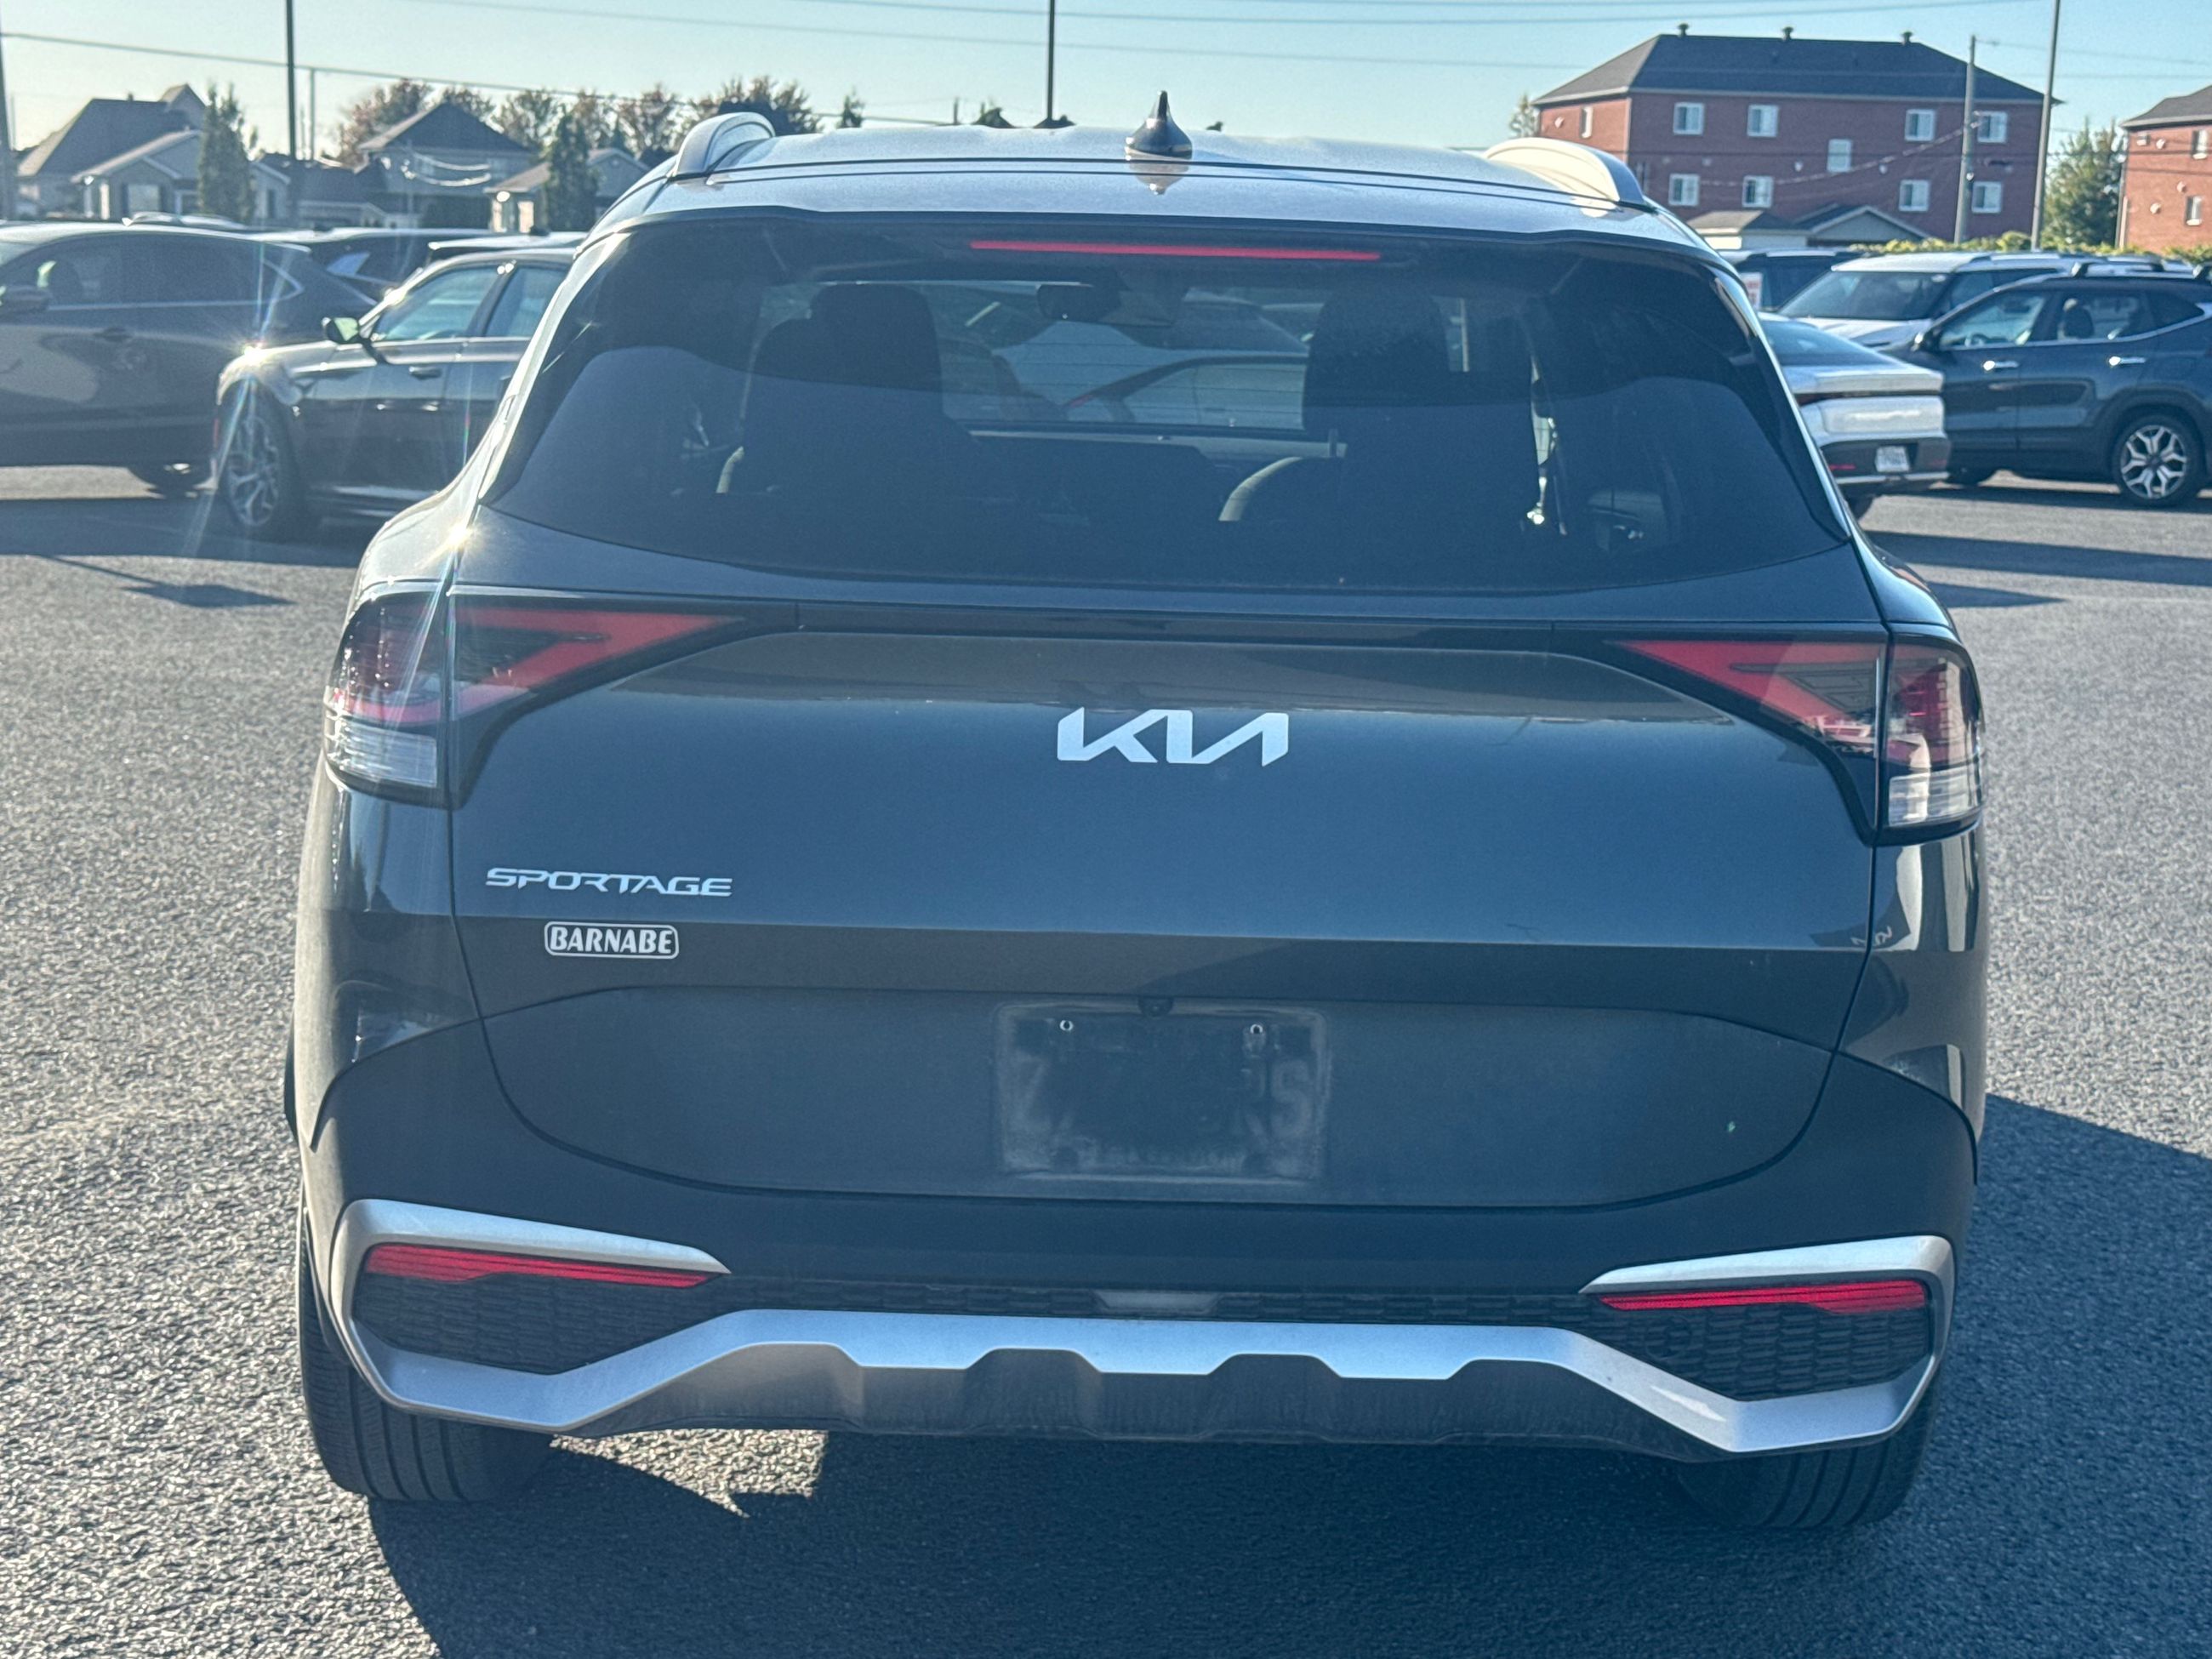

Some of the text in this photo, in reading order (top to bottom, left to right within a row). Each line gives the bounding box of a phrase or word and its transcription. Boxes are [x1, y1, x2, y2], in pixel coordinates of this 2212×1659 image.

[1058, 707, 1289, 767] KIA
[485, 868, 733, 897] SPORTAGE
[550, 926, 674, 954] BARNABE
